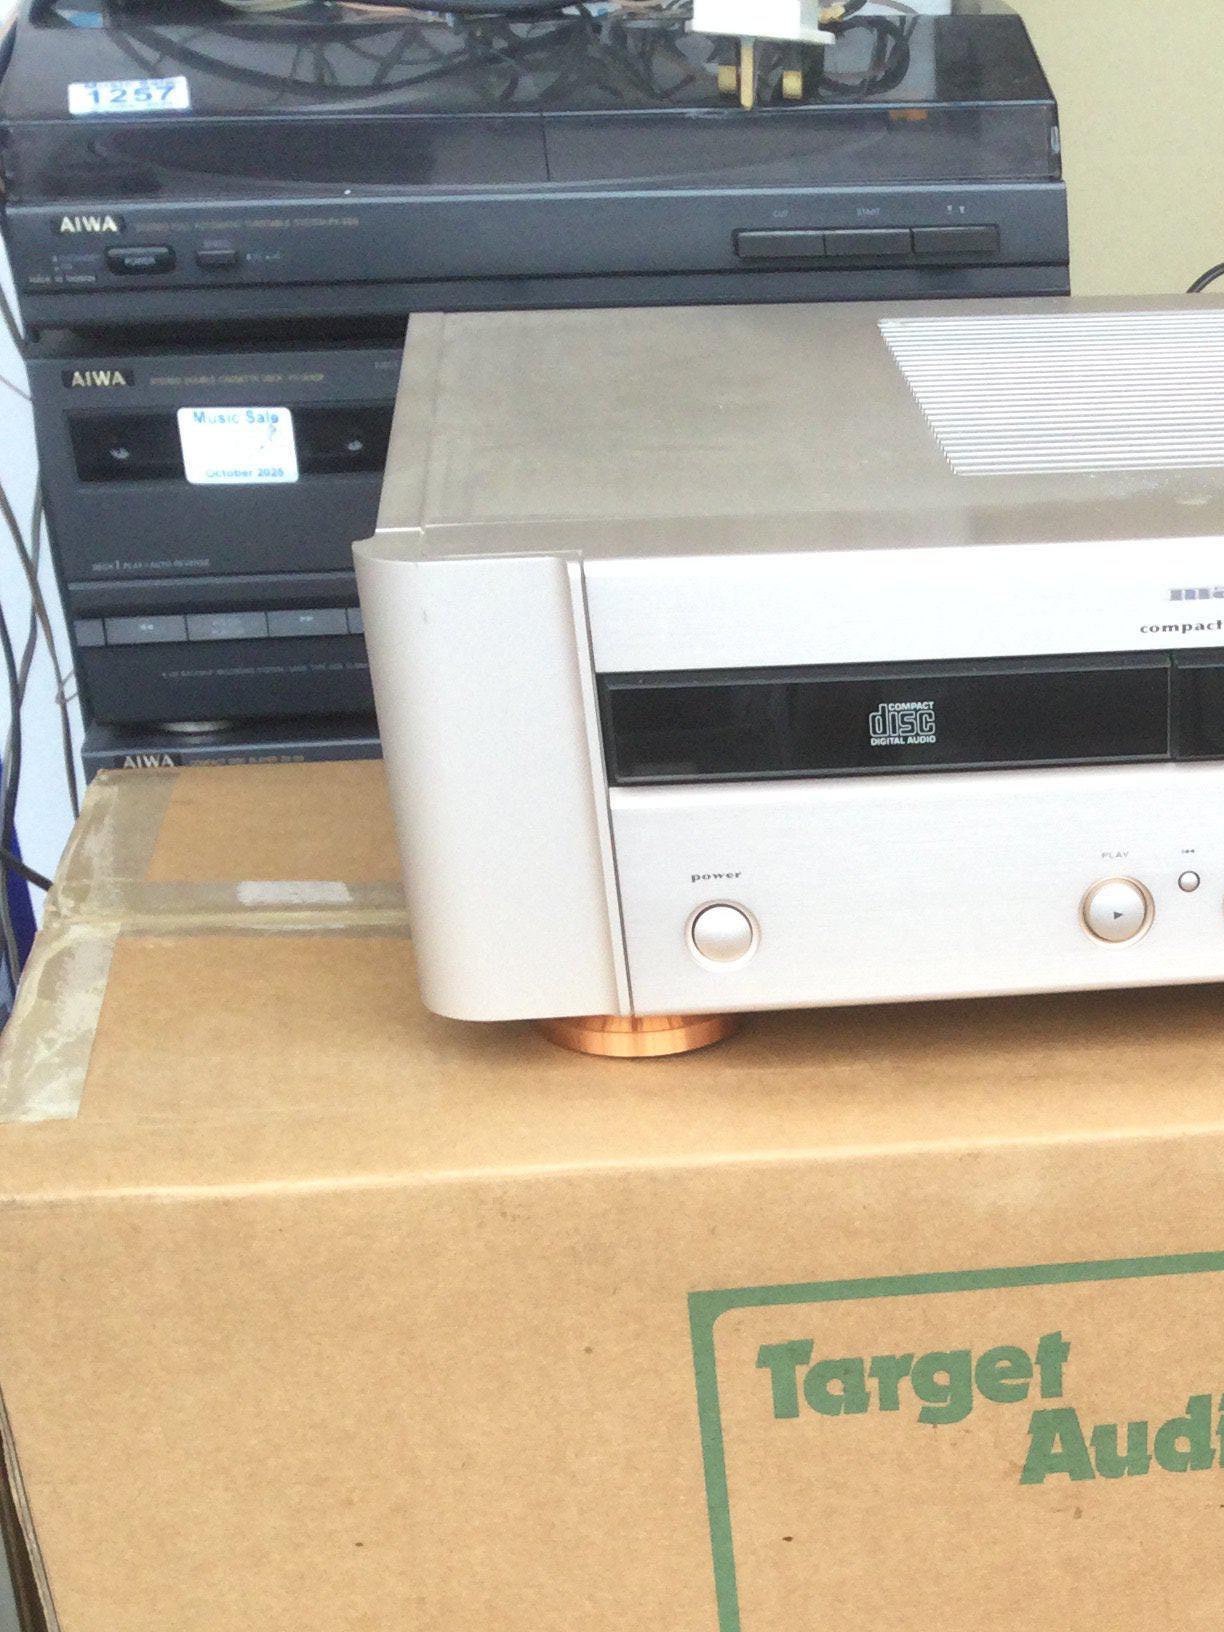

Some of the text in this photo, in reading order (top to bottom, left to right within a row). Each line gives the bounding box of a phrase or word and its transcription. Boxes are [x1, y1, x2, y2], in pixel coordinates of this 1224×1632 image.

[88, 83, 175, 103] 1257
[60, 214, 118, 233] AIWA
[71, 370, 126, 387] AIWA
[193, 410, 280, 424] Music Sale
[1140, 618, 1222, 634] compact
[888, 701, 935, 711] COMPACT
[870, 735, 937, 746] DIGITAL AUDIO
[122, 754, 175, 769] AIWA
[1101, 850, 1130, 860] PLAY
[691, 871, 742, 883] power
[756, 1330, 1072, 1426] Target
